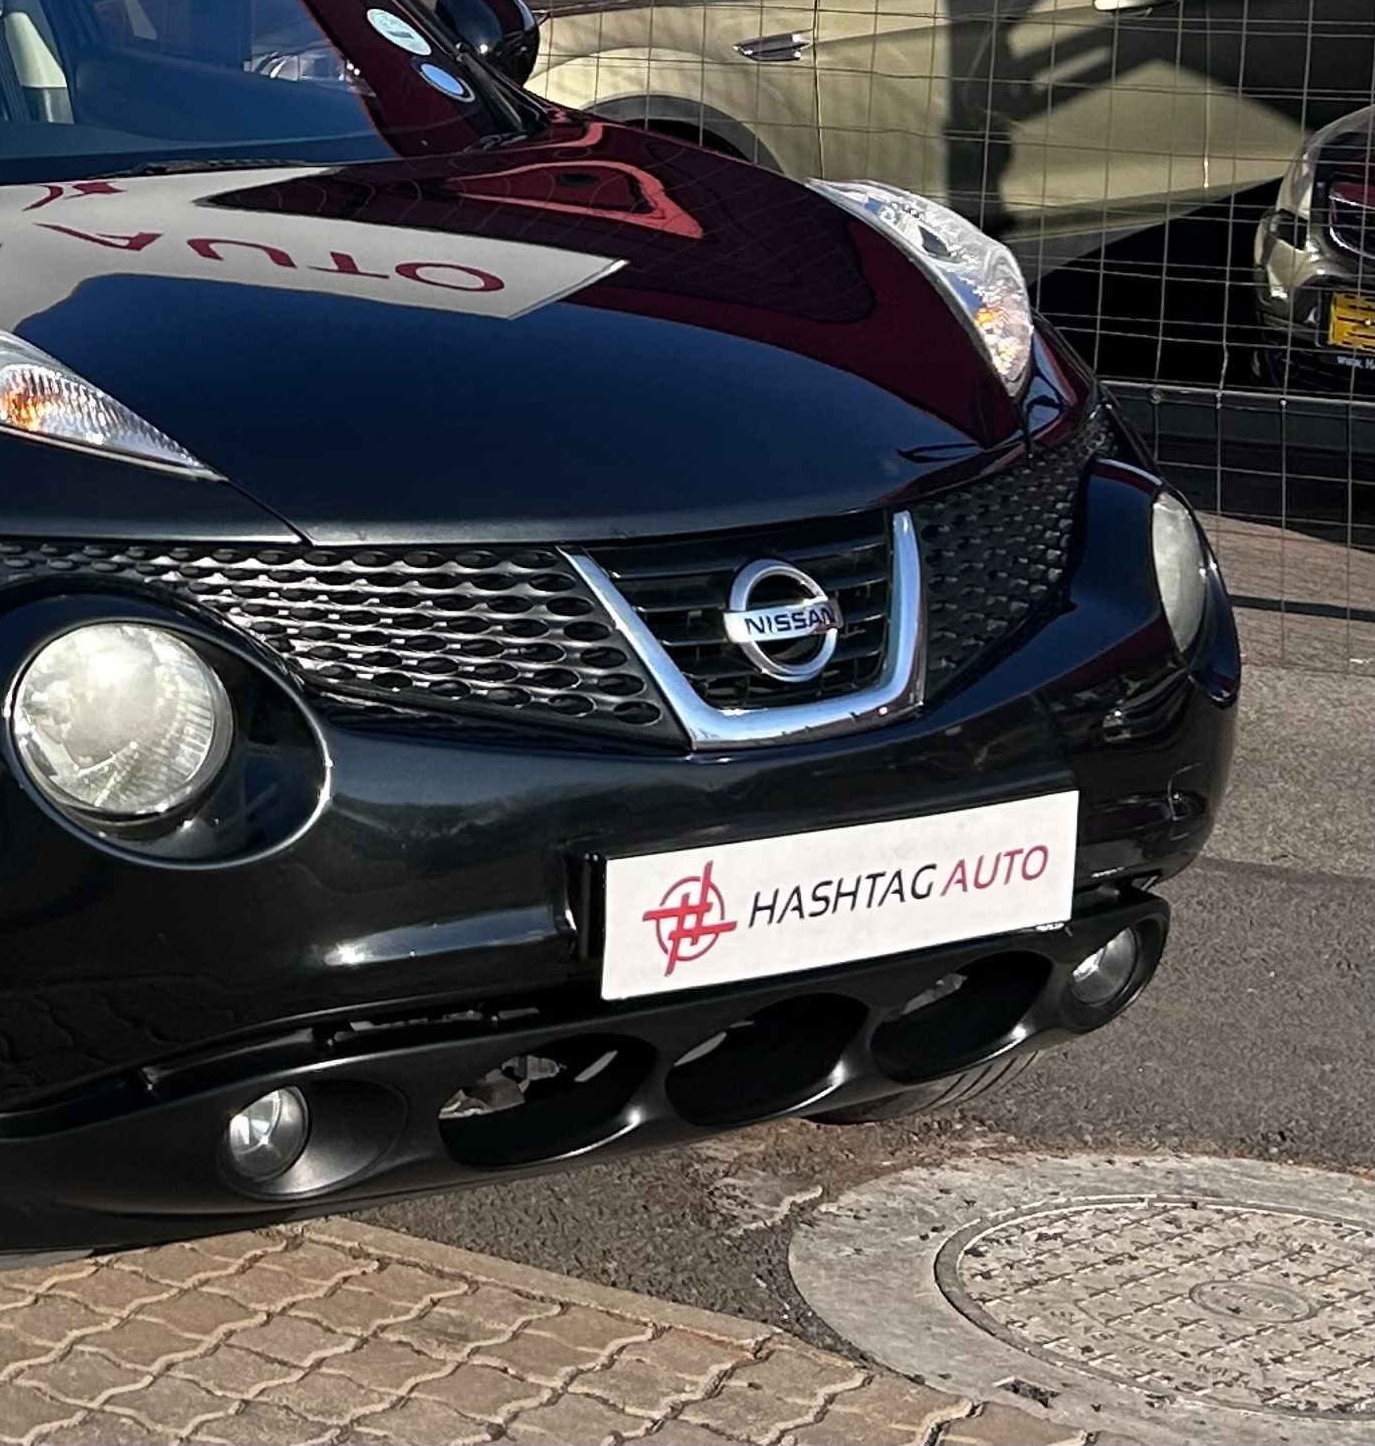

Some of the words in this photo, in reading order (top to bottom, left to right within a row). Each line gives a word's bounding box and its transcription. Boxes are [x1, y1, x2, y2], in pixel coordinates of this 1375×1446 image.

[743, 606, 837, 635] NISSAN
[748, 863, 937, 928] HASHTAG
[940, 844, 1049, 897] AUTO
